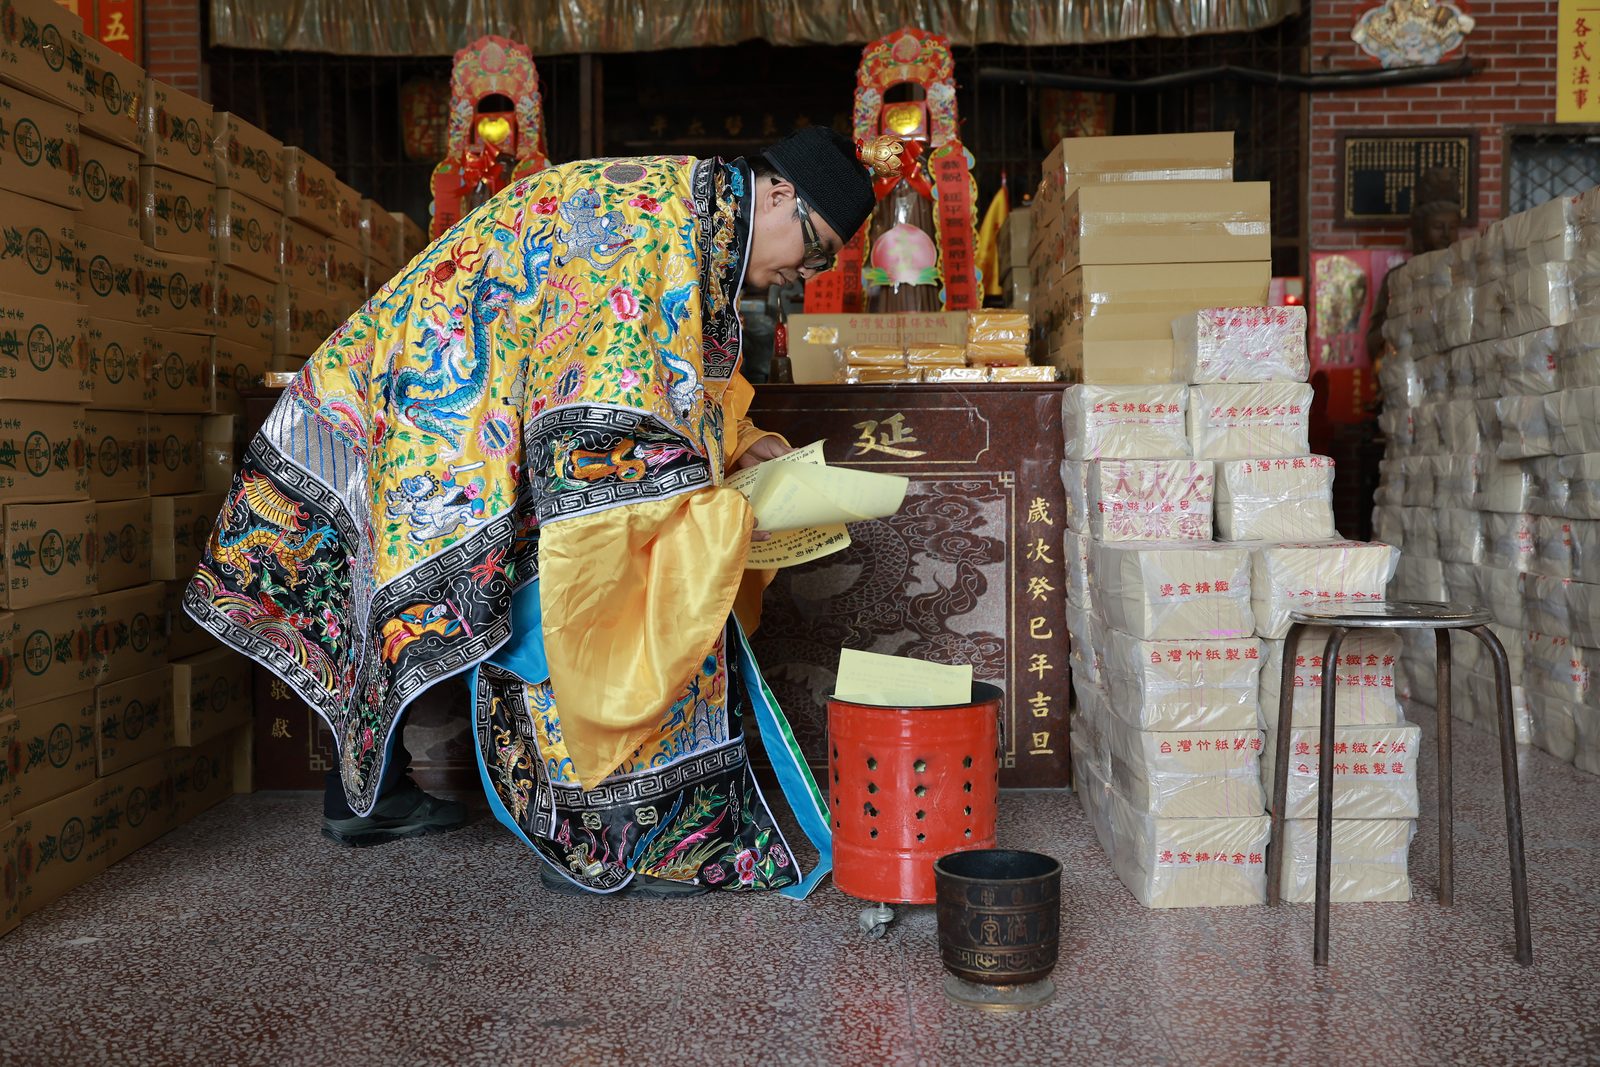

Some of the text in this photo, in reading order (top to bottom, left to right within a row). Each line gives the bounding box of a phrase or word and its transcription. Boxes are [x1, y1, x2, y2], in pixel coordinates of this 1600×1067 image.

[104, 12, 130, 41] 五
[1572, 17, 1592, 110] 各式法事
[853, 412, 927, 459] 延
[1026, 497, 1055, 755] 歲次癸巳年吉旦
[1150, 647, 1260, 664] 台灣竹紙製造
[1160, 737, 1262, 754] 台灣竹紙製造
[1158, 850, 1263, 865] 燙金精緻金紙
